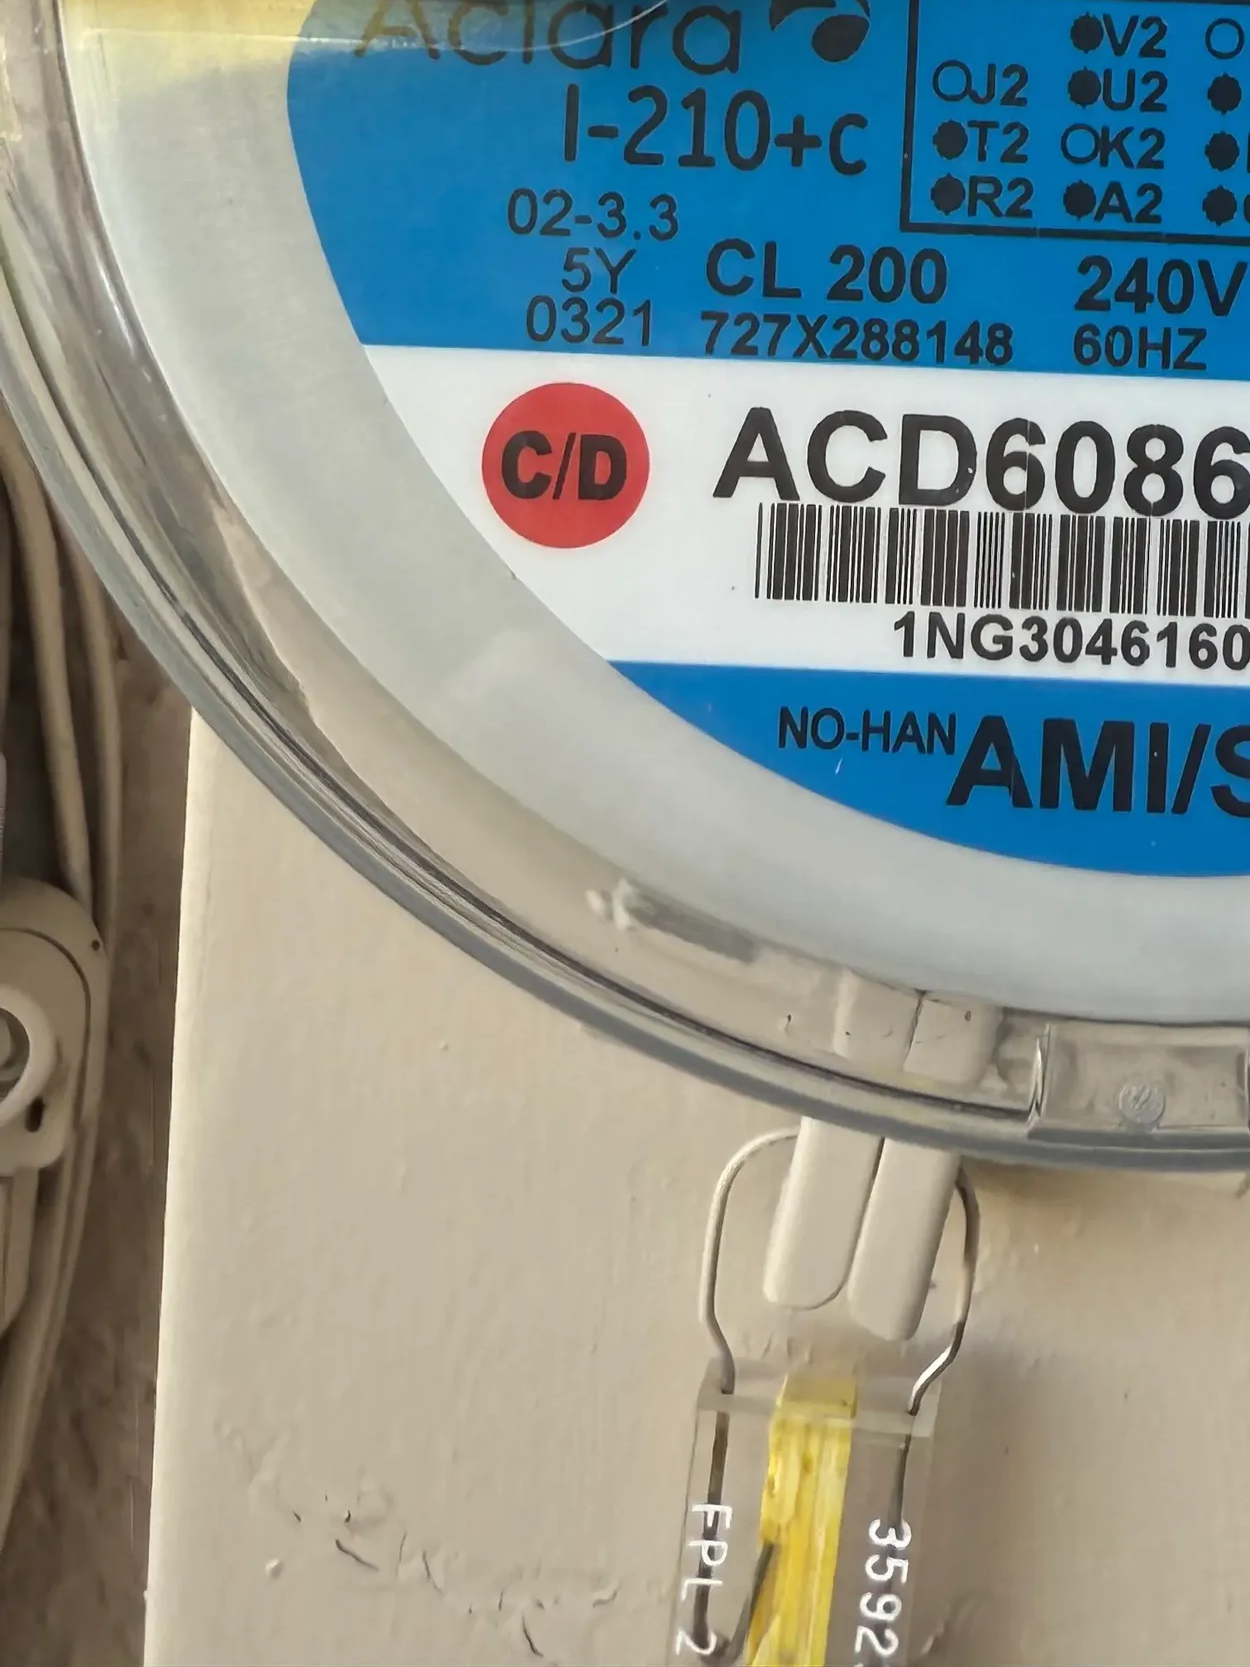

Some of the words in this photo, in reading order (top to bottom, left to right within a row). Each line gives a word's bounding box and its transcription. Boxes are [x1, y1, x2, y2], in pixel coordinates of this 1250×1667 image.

[1104, 14, 1168, 59] V2
[1103, 69, 1168, 113] U2
[968, 120, 1031, 164] T2
[1099, 125, 1166, 170] K2
[507, 188, 679, 242] 02-3.3
[967, 175, 1034, 220] R2
[1093, 181, 1163, 225] A2
[561, 248, 637, 294] 5Y
[705, 238, 801, 299] CL
[826, 243, 948, 306] 200
[1073, 255, 1249, 317] 240V
[525, 295, 653, 347] 0321
[699, 311, 1014, 366] 727X288148
[1073, 324, 1207, 371] 60HZ
[501, 431, 628, 502] C/D
[778, 706, 957, 755] NO-HAN
[680, 1503, 734, 1602] FPL
[851, 1518, 913, 1667] 3592
